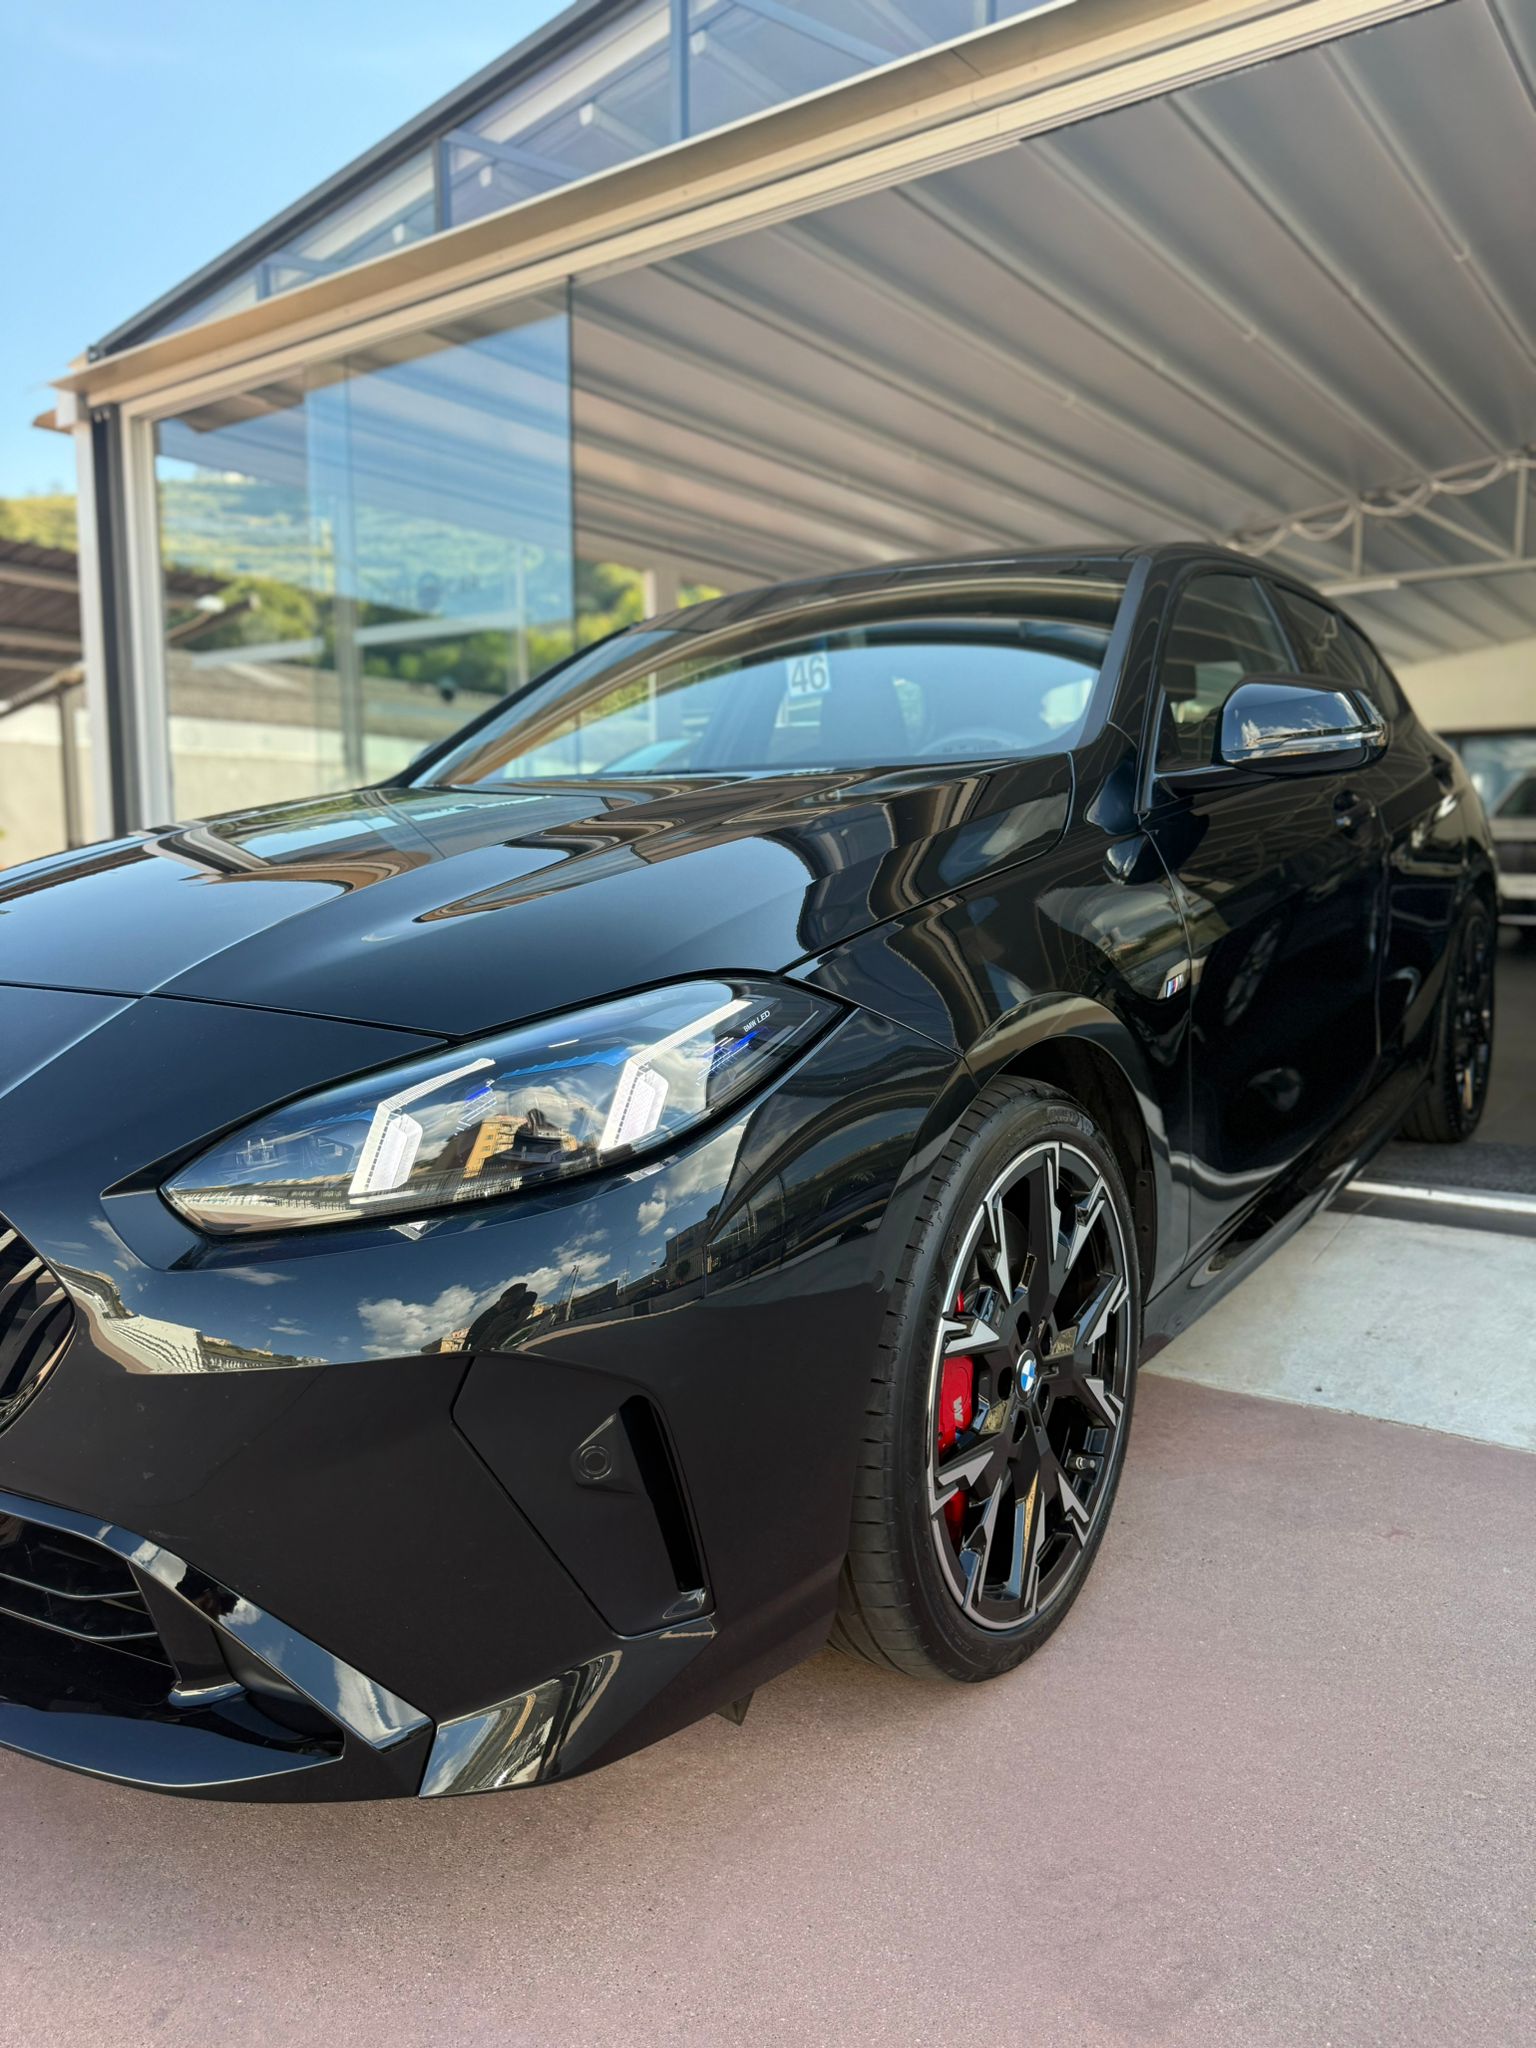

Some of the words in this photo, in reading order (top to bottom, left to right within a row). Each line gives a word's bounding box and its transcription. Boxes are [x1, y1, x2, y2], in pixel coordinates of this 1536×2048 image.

[791, 655, 826, 693] 46
[743, 1019, 757, 1033] BMW
[756, 1010, 771, 1024] LED
